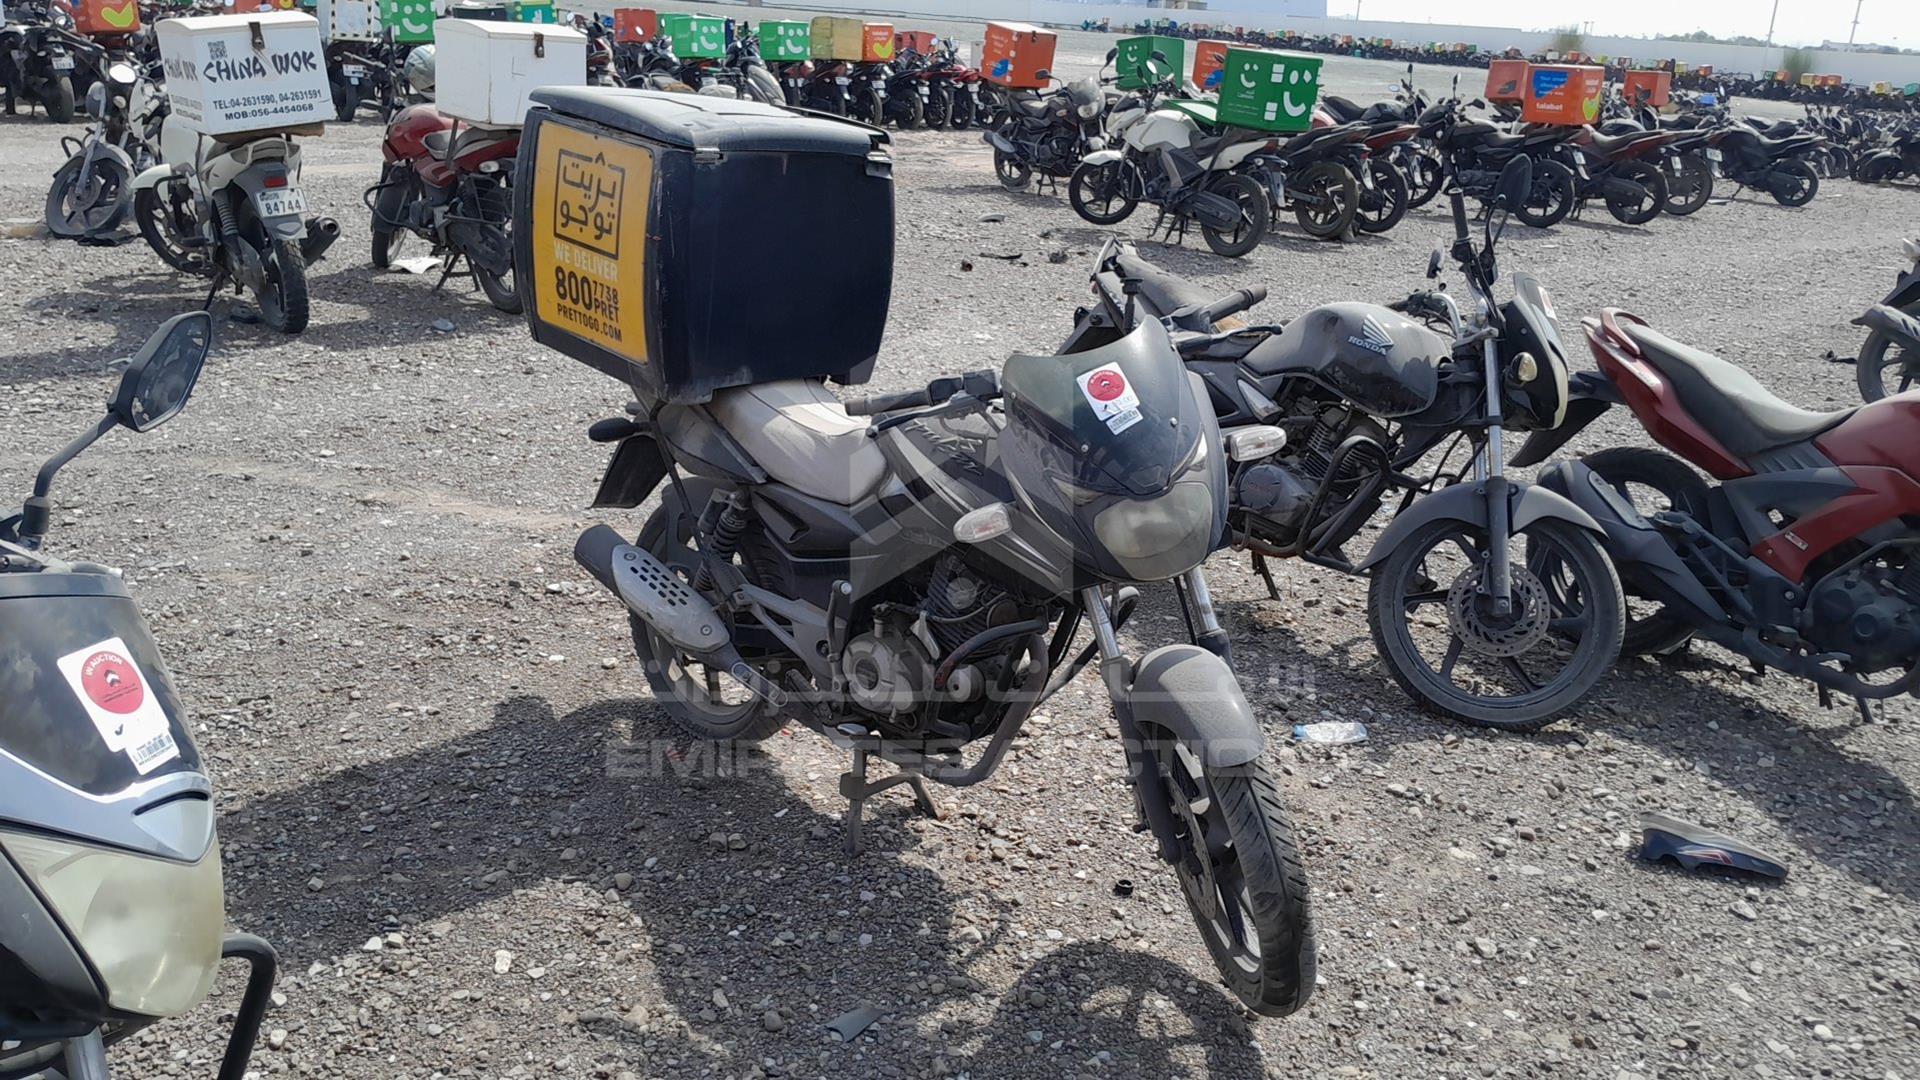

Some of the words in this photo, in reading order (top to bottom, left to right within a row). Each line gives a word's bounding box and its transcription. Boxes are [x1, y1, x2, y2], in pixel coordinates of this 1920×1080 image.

[203, 56, 267, 83] CHINA
[271, 50, 318, 75] WOK
[213, 94, 278, 110] TEL:04-2631590,
[279, 89, 322, 103] 04-2631591
[225, 103, 314, 121] MOB:056-4454068
[265, 200, 302, 215] 84744
[560, 200, 616, 240] توجو
[554, 240, 571, 263] WE
[574, 248, 619, 282] DELIVER
[555, 266, 593, 311] 800
[592, 280, 618, 305] 7738
[557, 303, 622, 343] PRETTOGO.COM
[594, 298, 620, 324] PRET
[1347, 335, 1387, 356] HONDA
[90, 653, 123, 668] AUCTION
